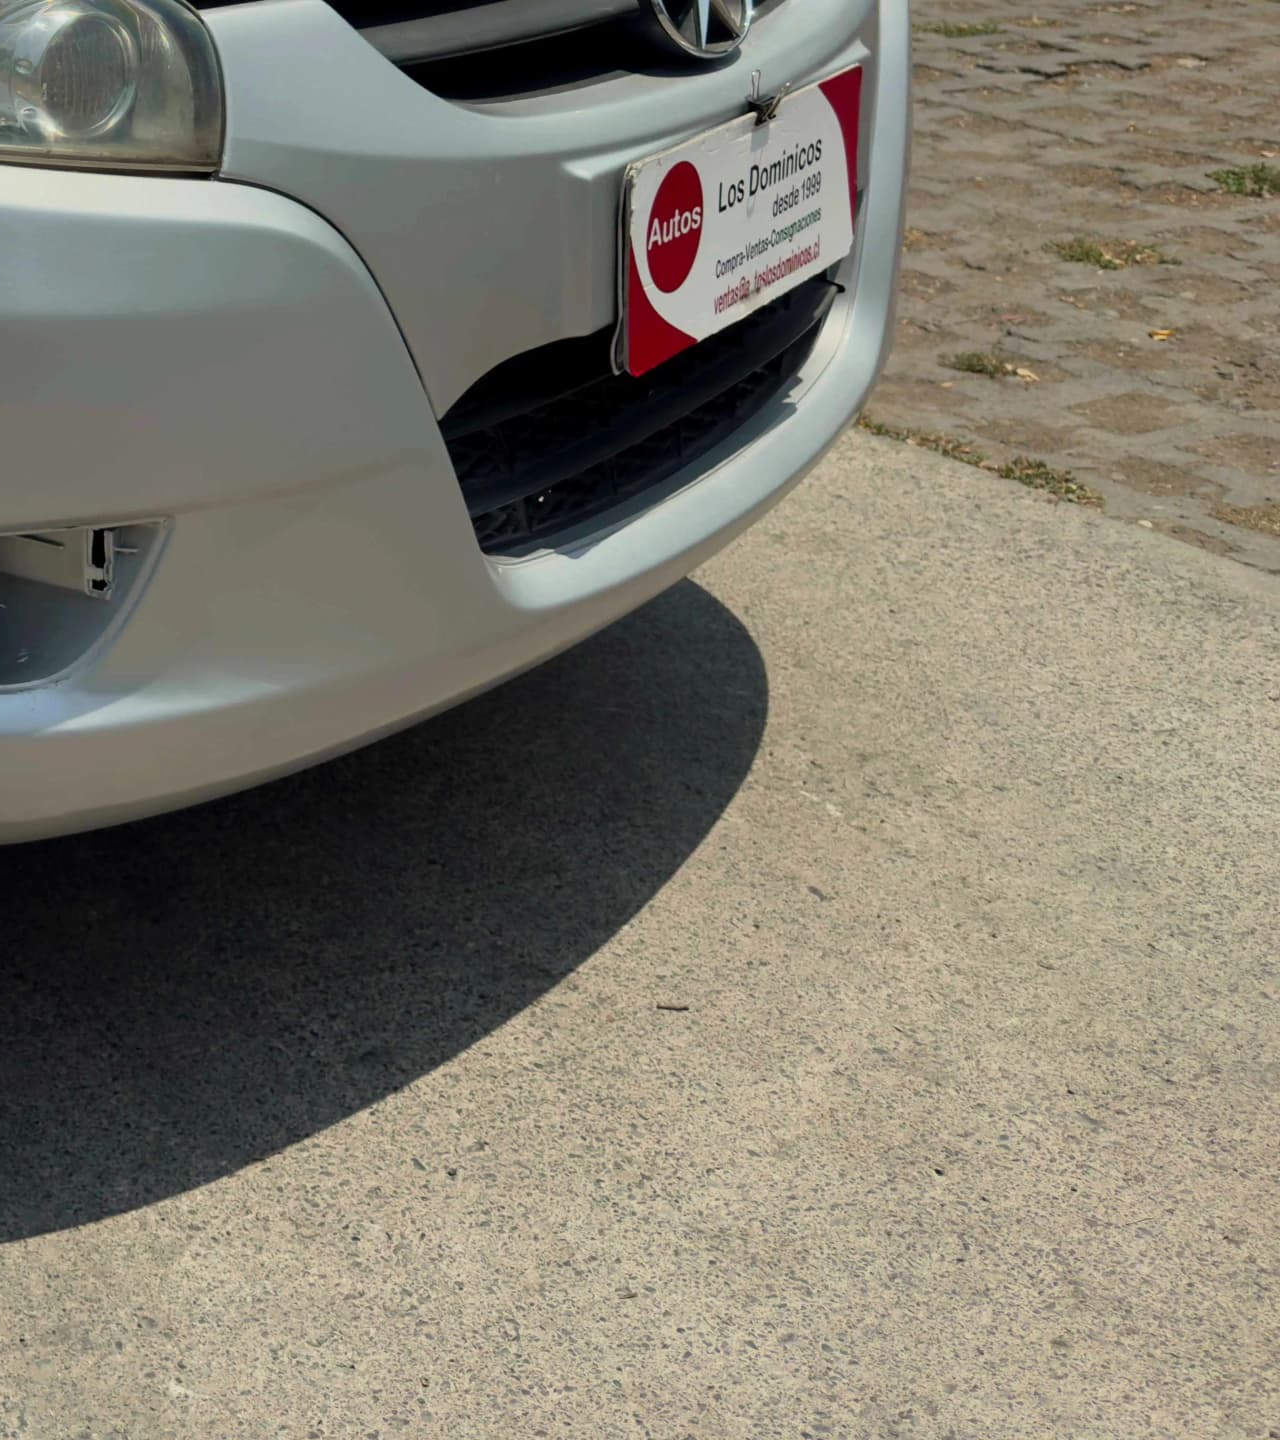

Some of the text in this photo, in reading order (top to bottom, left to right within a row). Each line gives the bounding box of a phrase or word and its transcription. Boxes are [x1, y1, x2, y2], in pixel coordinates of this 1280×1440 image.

[718, 138, 823, 213] Los Dominicos
[772, 171, 822, 218] desde 1999
[648, 206, 702, 250] Autos
[713, 234, 821, 315] ventas@atoslosdominicos.cl
